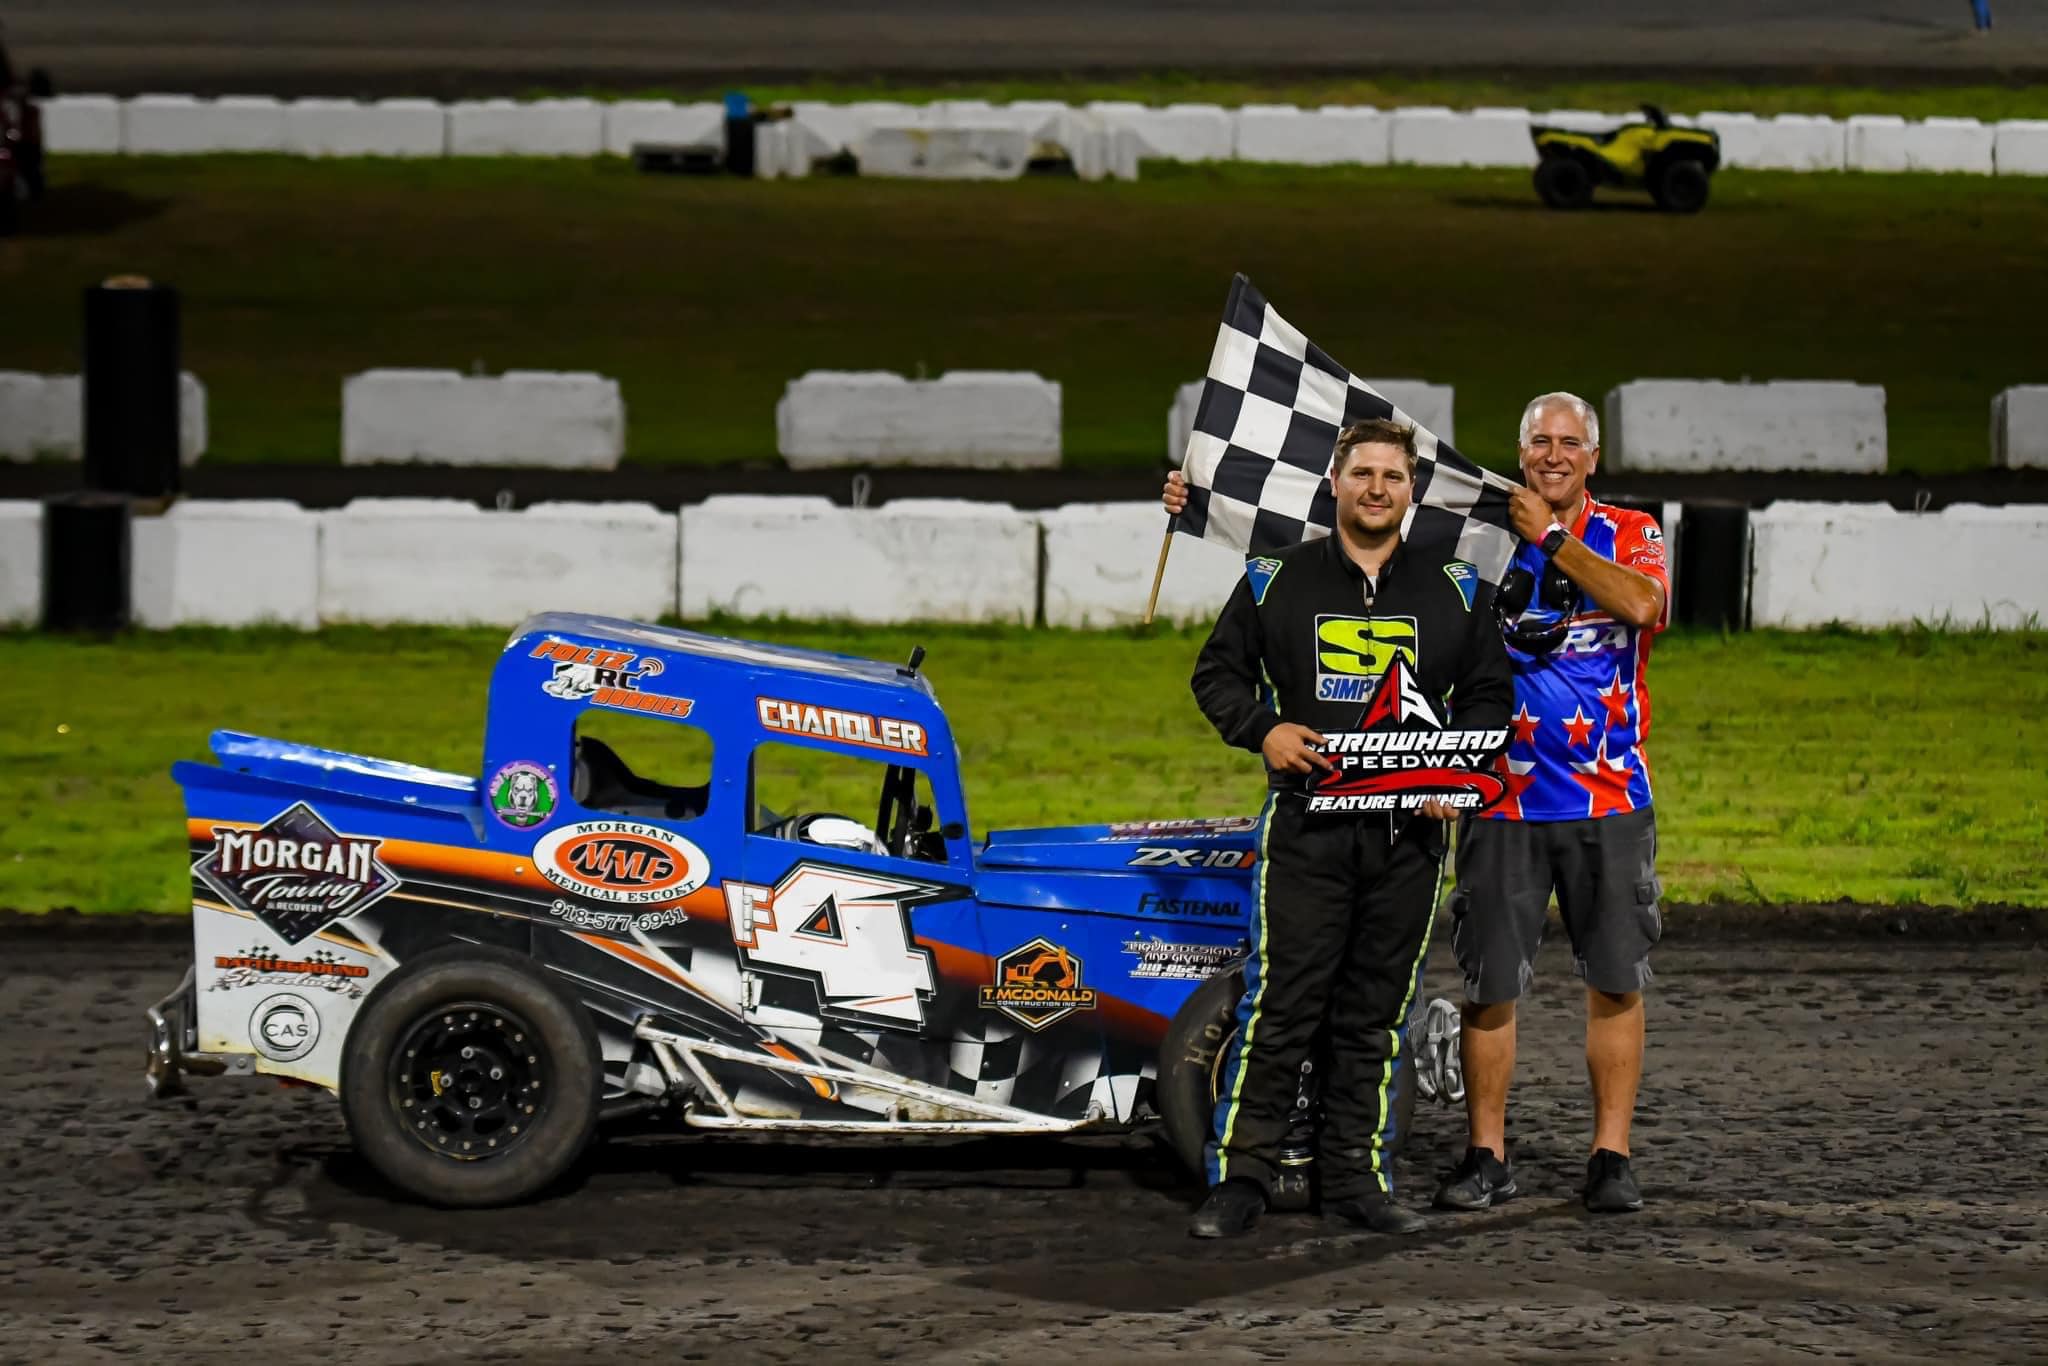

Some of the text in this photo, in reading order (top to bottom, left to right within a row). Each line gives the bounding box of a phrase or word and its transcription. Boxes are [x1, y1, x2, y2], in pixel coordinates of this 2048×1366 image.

[531, 640, 636, 669] FOLTZ
[594, 667, 640, 691] RC
[758, 699, 922, 752] CHANDLER
[1305, 732, 1507, 752] RROWHEAD
[1309, 795, 1398, 811] FEATURE
[576, 823, 675, 843] MORGAN
[218, 833, 374, 883] MORGAN
[242, 874, 363, 909] Towing
[545, 870, 696, 902] MEDICAL ESCORT
[276, 902, 324, 913] RECOVERY
[550, 899, 688, 932] 918-577-6941
[264, 1023, 309, 1038] CAS
